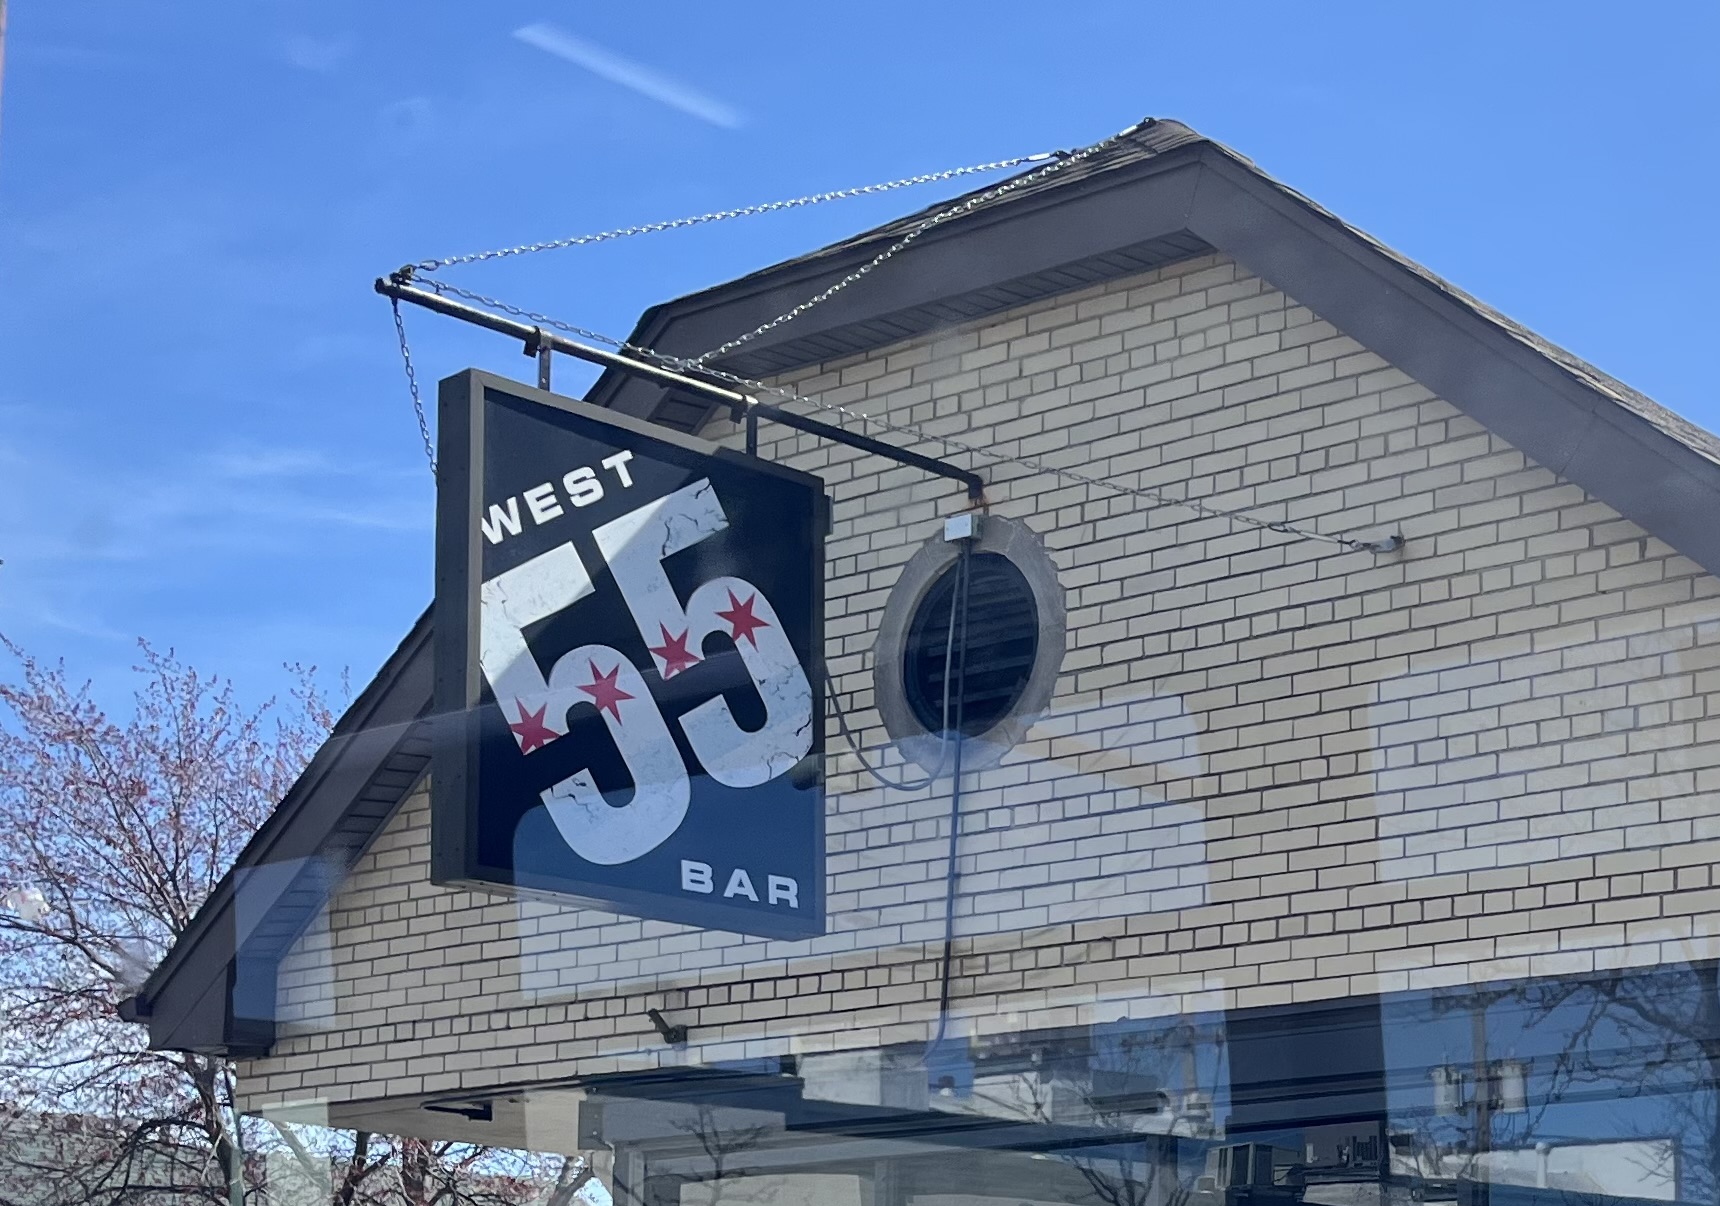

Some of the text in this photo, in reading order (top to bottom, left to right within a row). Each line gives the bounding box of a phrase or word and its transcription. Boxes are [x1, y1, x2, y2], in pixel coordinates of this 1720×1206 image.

[481, 449, 634, 545] WEST
[480, 477, 813, 865] 55
[680, 859, 799, 908] BAR
